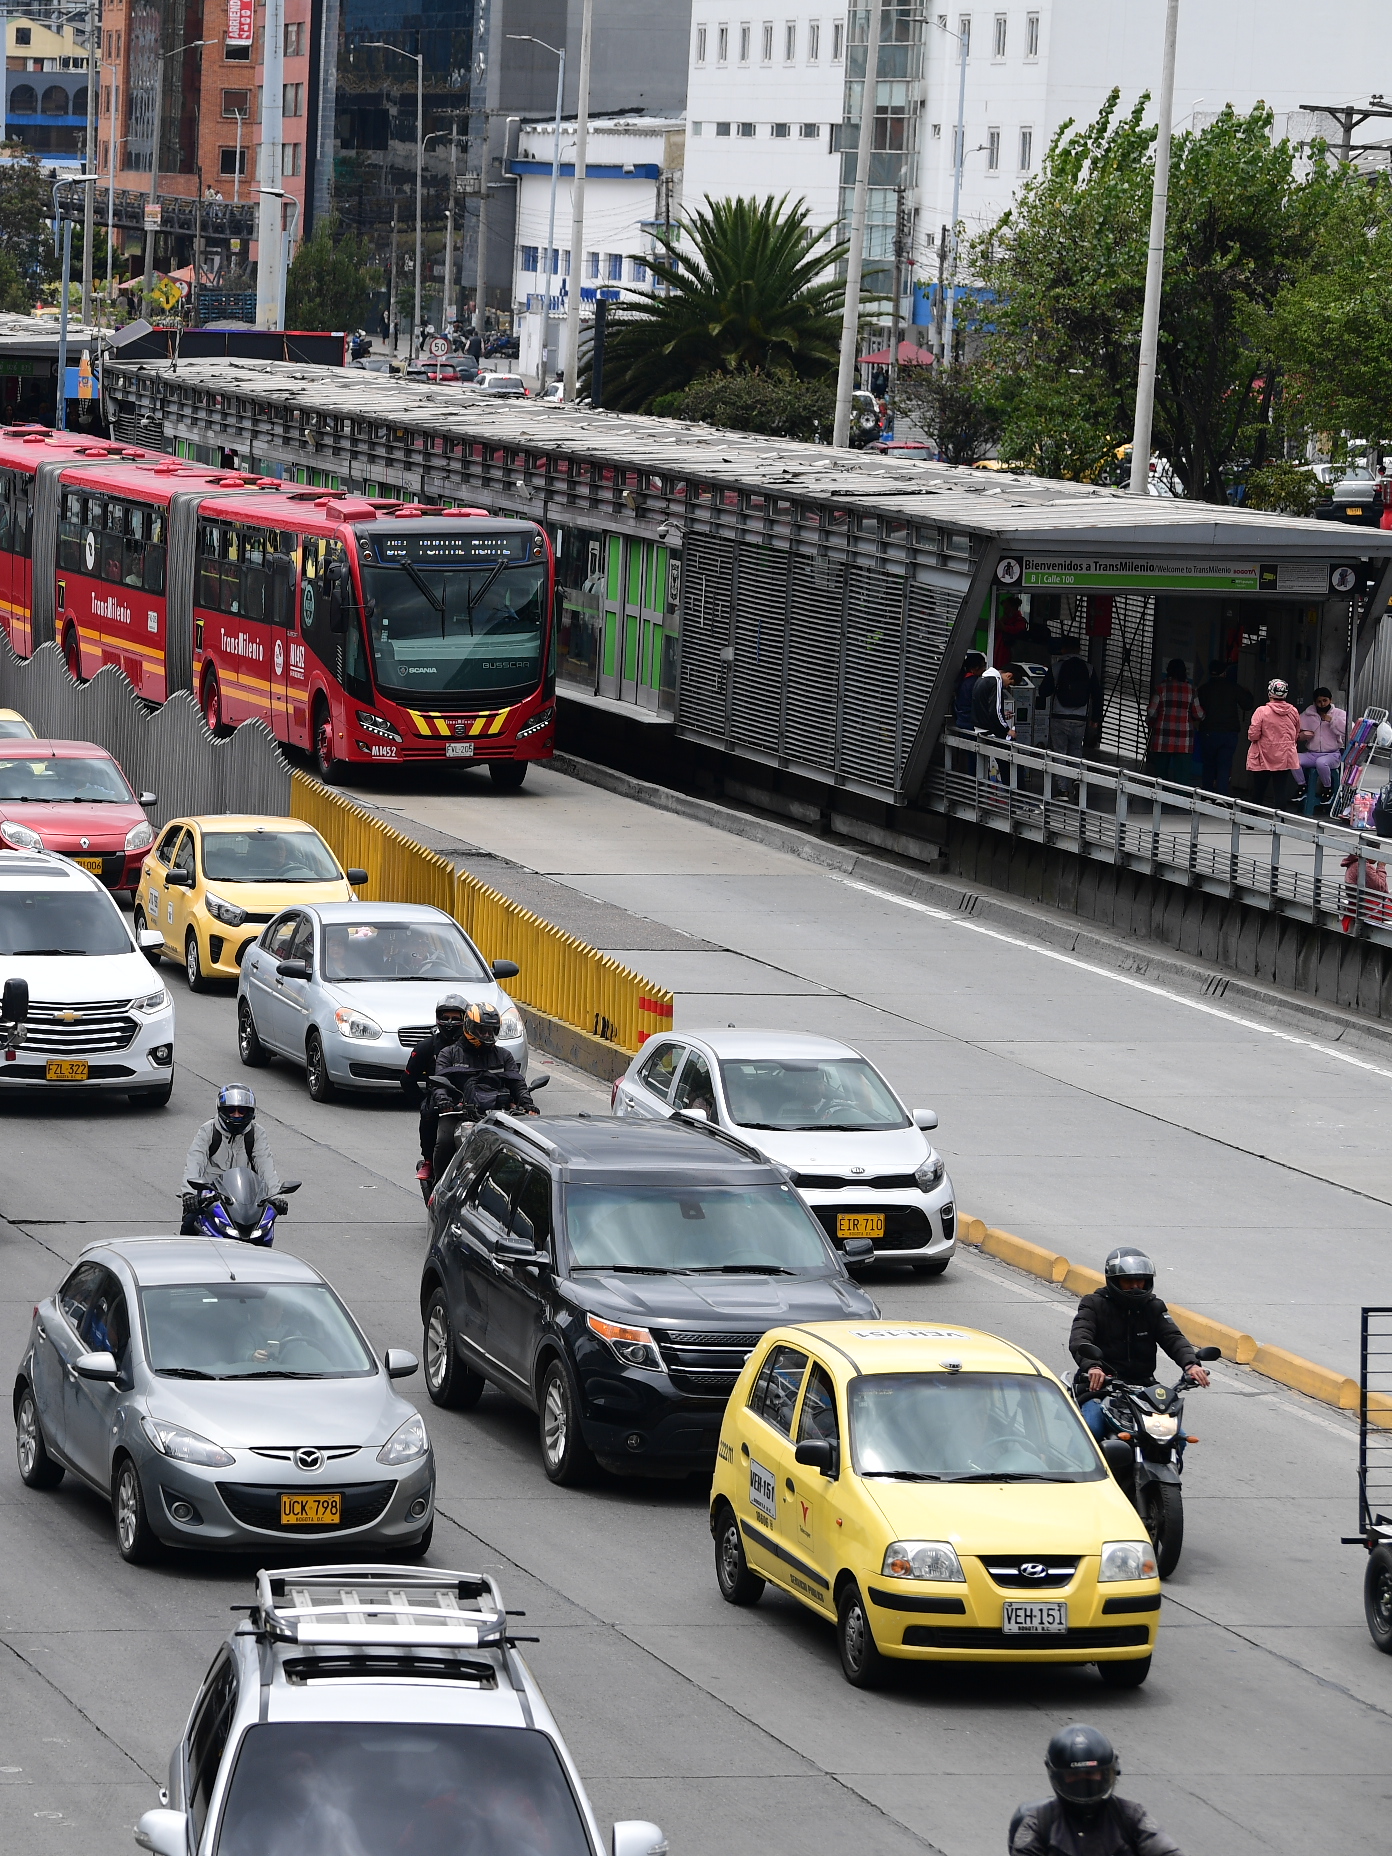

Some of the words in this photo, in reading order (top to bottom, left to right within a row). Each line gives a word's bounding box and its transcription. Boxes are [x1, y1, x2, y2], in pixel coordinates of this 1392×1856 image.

[434, 343, 446, 351] 50
[1025, 559, 1084, 572] Bienvenidos
[1086, 563, 1091, 571] a
[1043, 575, 1060, 583] Calle
[91, 591, 131, 624] TransMilenio
[220, 629, 264, 662] TransMilenio
